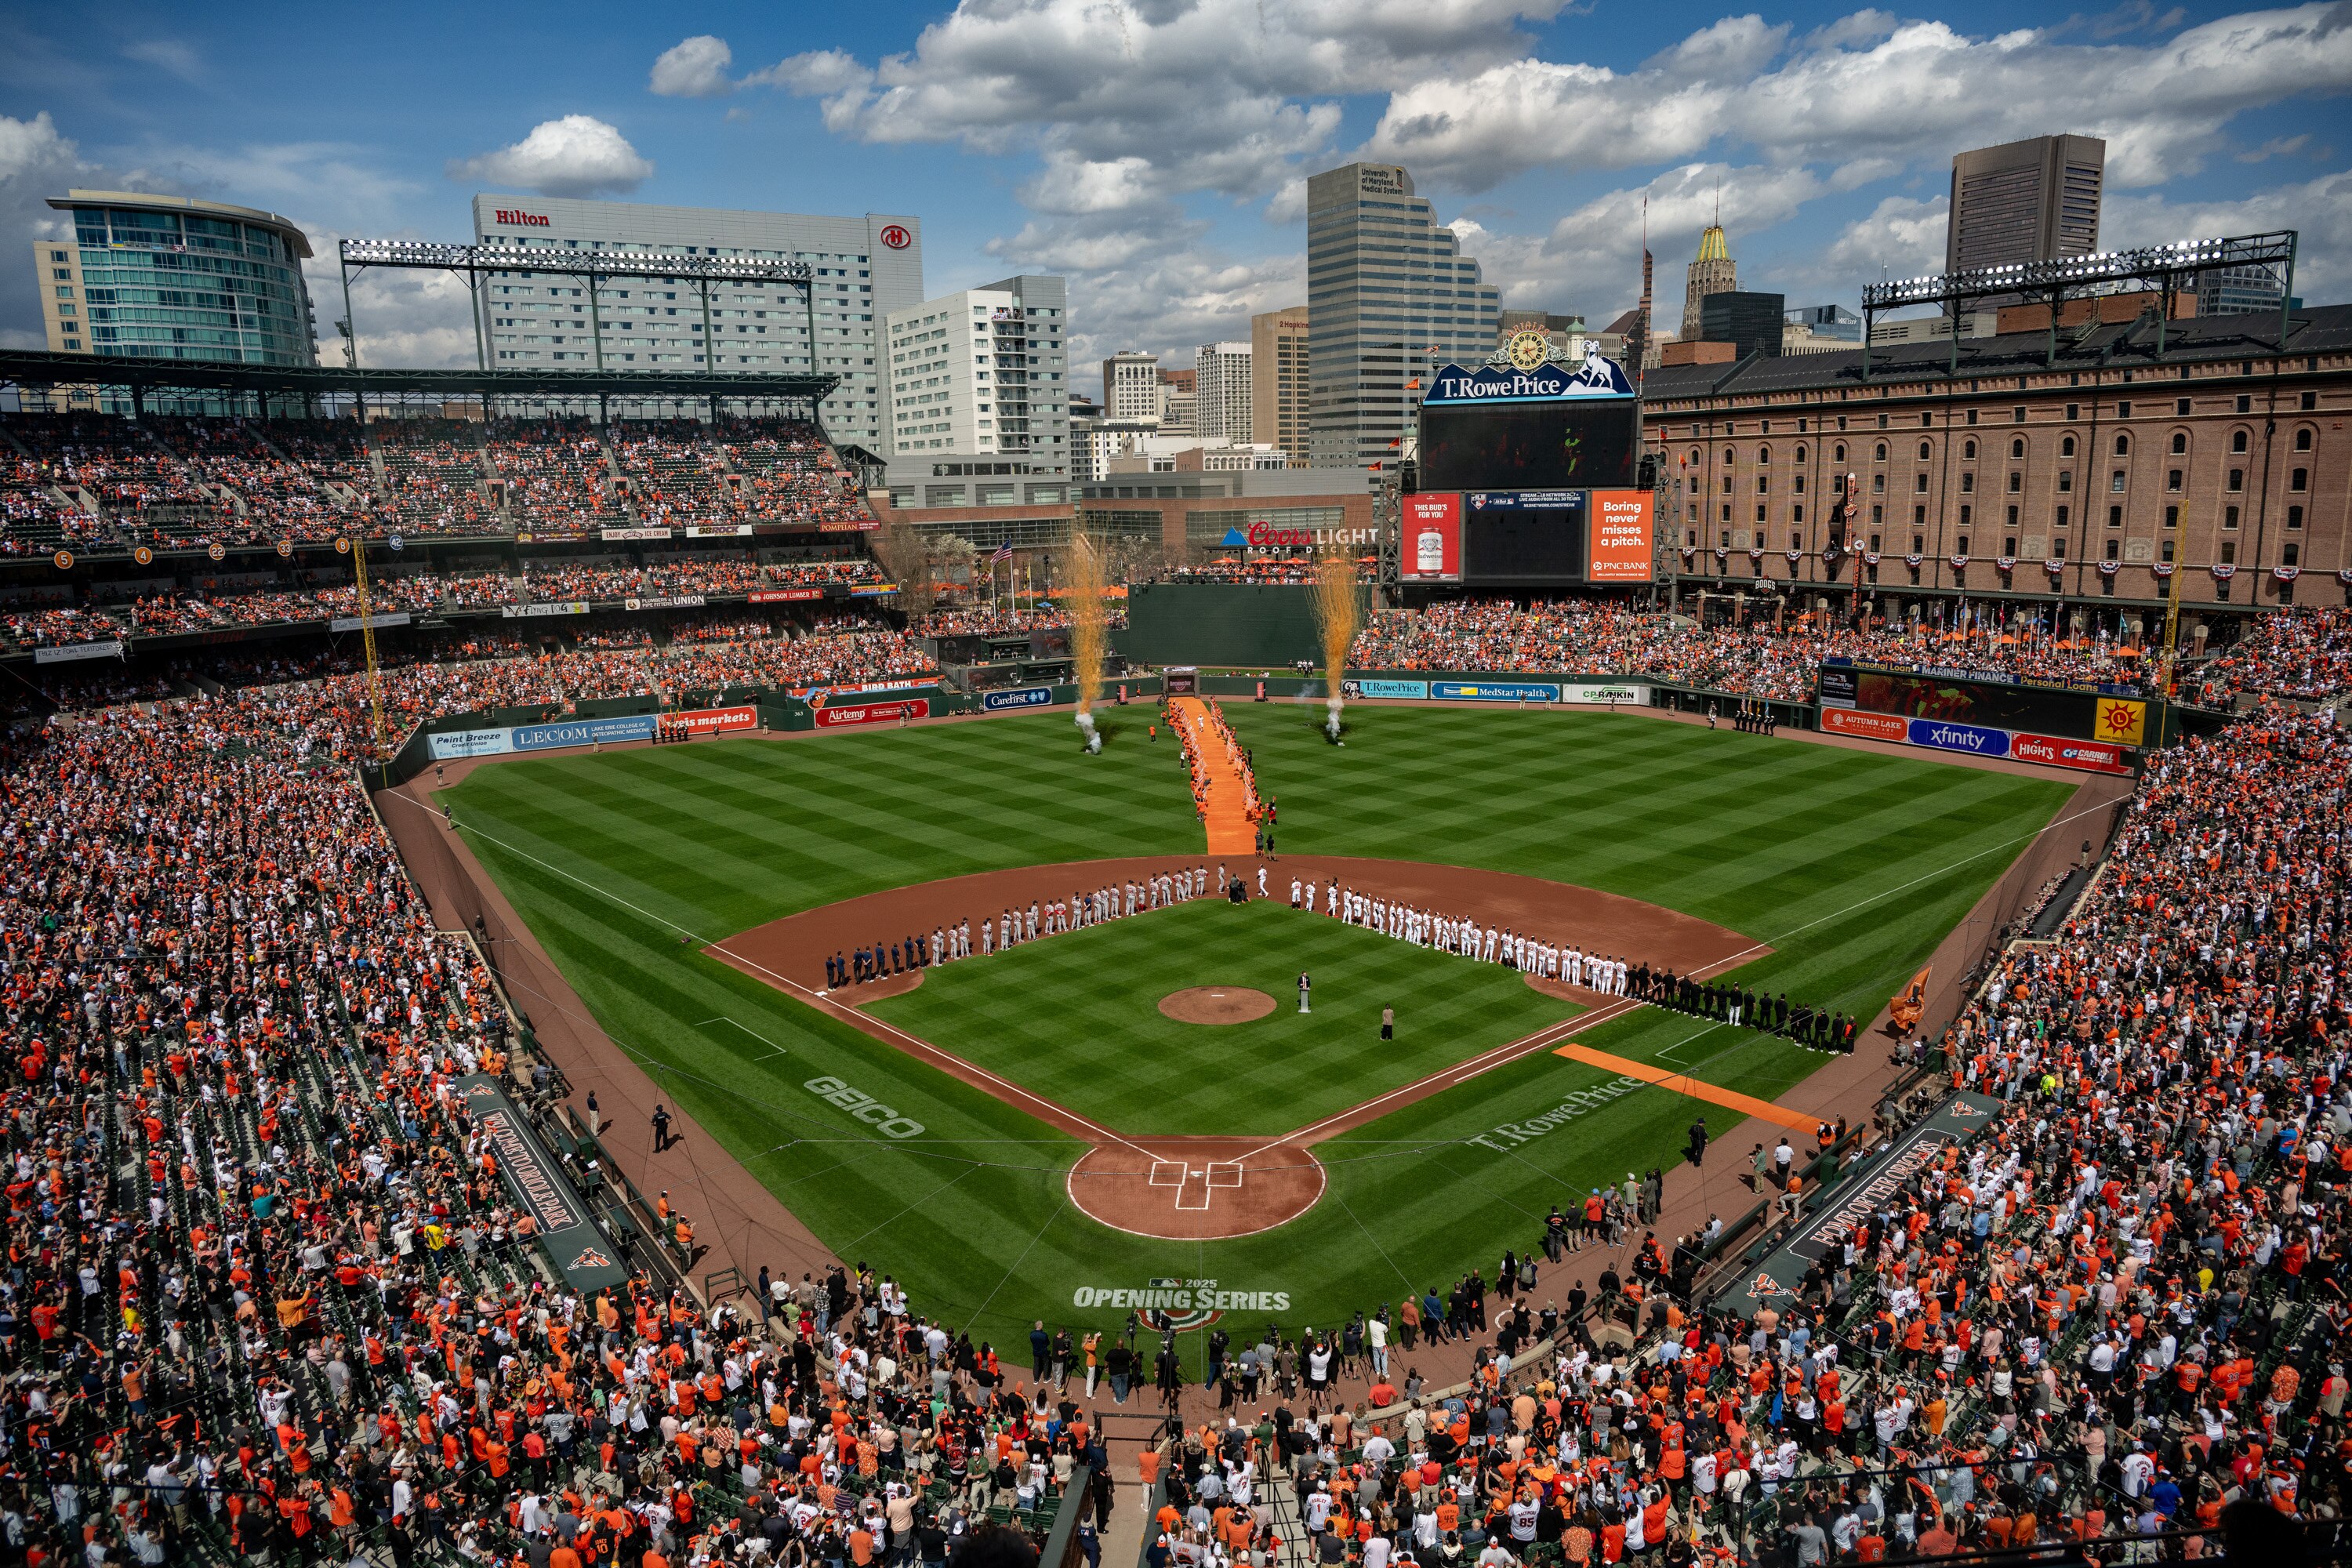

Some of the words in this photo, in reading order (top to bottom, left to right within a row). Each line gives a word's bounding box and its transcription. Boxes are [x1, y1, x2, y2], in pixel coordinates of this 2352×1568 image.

[1361, 168, 1389, 179] University
[1368, 177, 1394, 187] Maryland
[1361, 184, 1382, 193] Medical
[1383, 187, 1403, 195] System
[495, 209, 550, 227] Hilton
[1508, 321, 1550, 339] ORIOLES
[1603, 501, 1642, 514] Boring
[1247, 521, 1312, 546] Coors
[1316, 528, 1379, 545] LIGHT
[1602, 524, 1642, 535] misses
[339, 541, 346, 550] 8
[390, 538, 402, 548] 42
[1601, 538, 1609, 546] a
[1611, 535, 1645, 548] pitch.
[212, 547, 223, 557] 22
[279, 543, 291, 553] 33
[1247, 546, 1291, 554] ROOF
[1305, 546, 1350, 554] DECK
[60, 554, 68, 565] 5
[140, 550, 147, 561] 4
[673, 594, 704, 605] UNION
[763, 592, 788, 601] JOHNSON
[1851, 659, 1888, 671] Personal
[1921, 667, 1966, 680] MARINER
[2020, 676, 2065, 689] Personal
[2067, 682, 2099, 692] Loans
[862, 683, 887, 691] BIRD
[887, 681, 912, 689] BATH
[1397, 682, 1420, 692] Price
[1479, 688, 1517, 697] MedStar
[1518, 689, 1546, 698] Health
[697, 712, 750, 727] markets
[828, 709, 866, 721] Airtemp
[1846, 715, 1879, 726] AUTUMN
[1880, 719, 1901, 730] LAKE
[465, 733, 501, 742] Breeze
[591, 729, 626, 738] OSTEOPATHIC
[1930, 726, 1986, 750] xfinity
[2019, 743, 2054, 760] HIGH'S
[2077, 750, 2114, 762] CARROLL
[1562, 1076, 1646, 1109] Price
[803, 1076, 926, 1139] GEICO
[515, 1164, 557, 1203] ORIOLE
[535, 1196, 573, 1229] PARK
[1185, 1279, 1218, 1288] 2025
[1073, 1286, 1191, 1309] OPENING
[1195, 1288, 1290, 1311] SERIES
[2140, 1466, 2148, 1478] 2
[1443, 1515, 1454, 1523] 45
[1519, 1518, 1534, 1527] 85
[596, 1543, 608, 1554] 10
